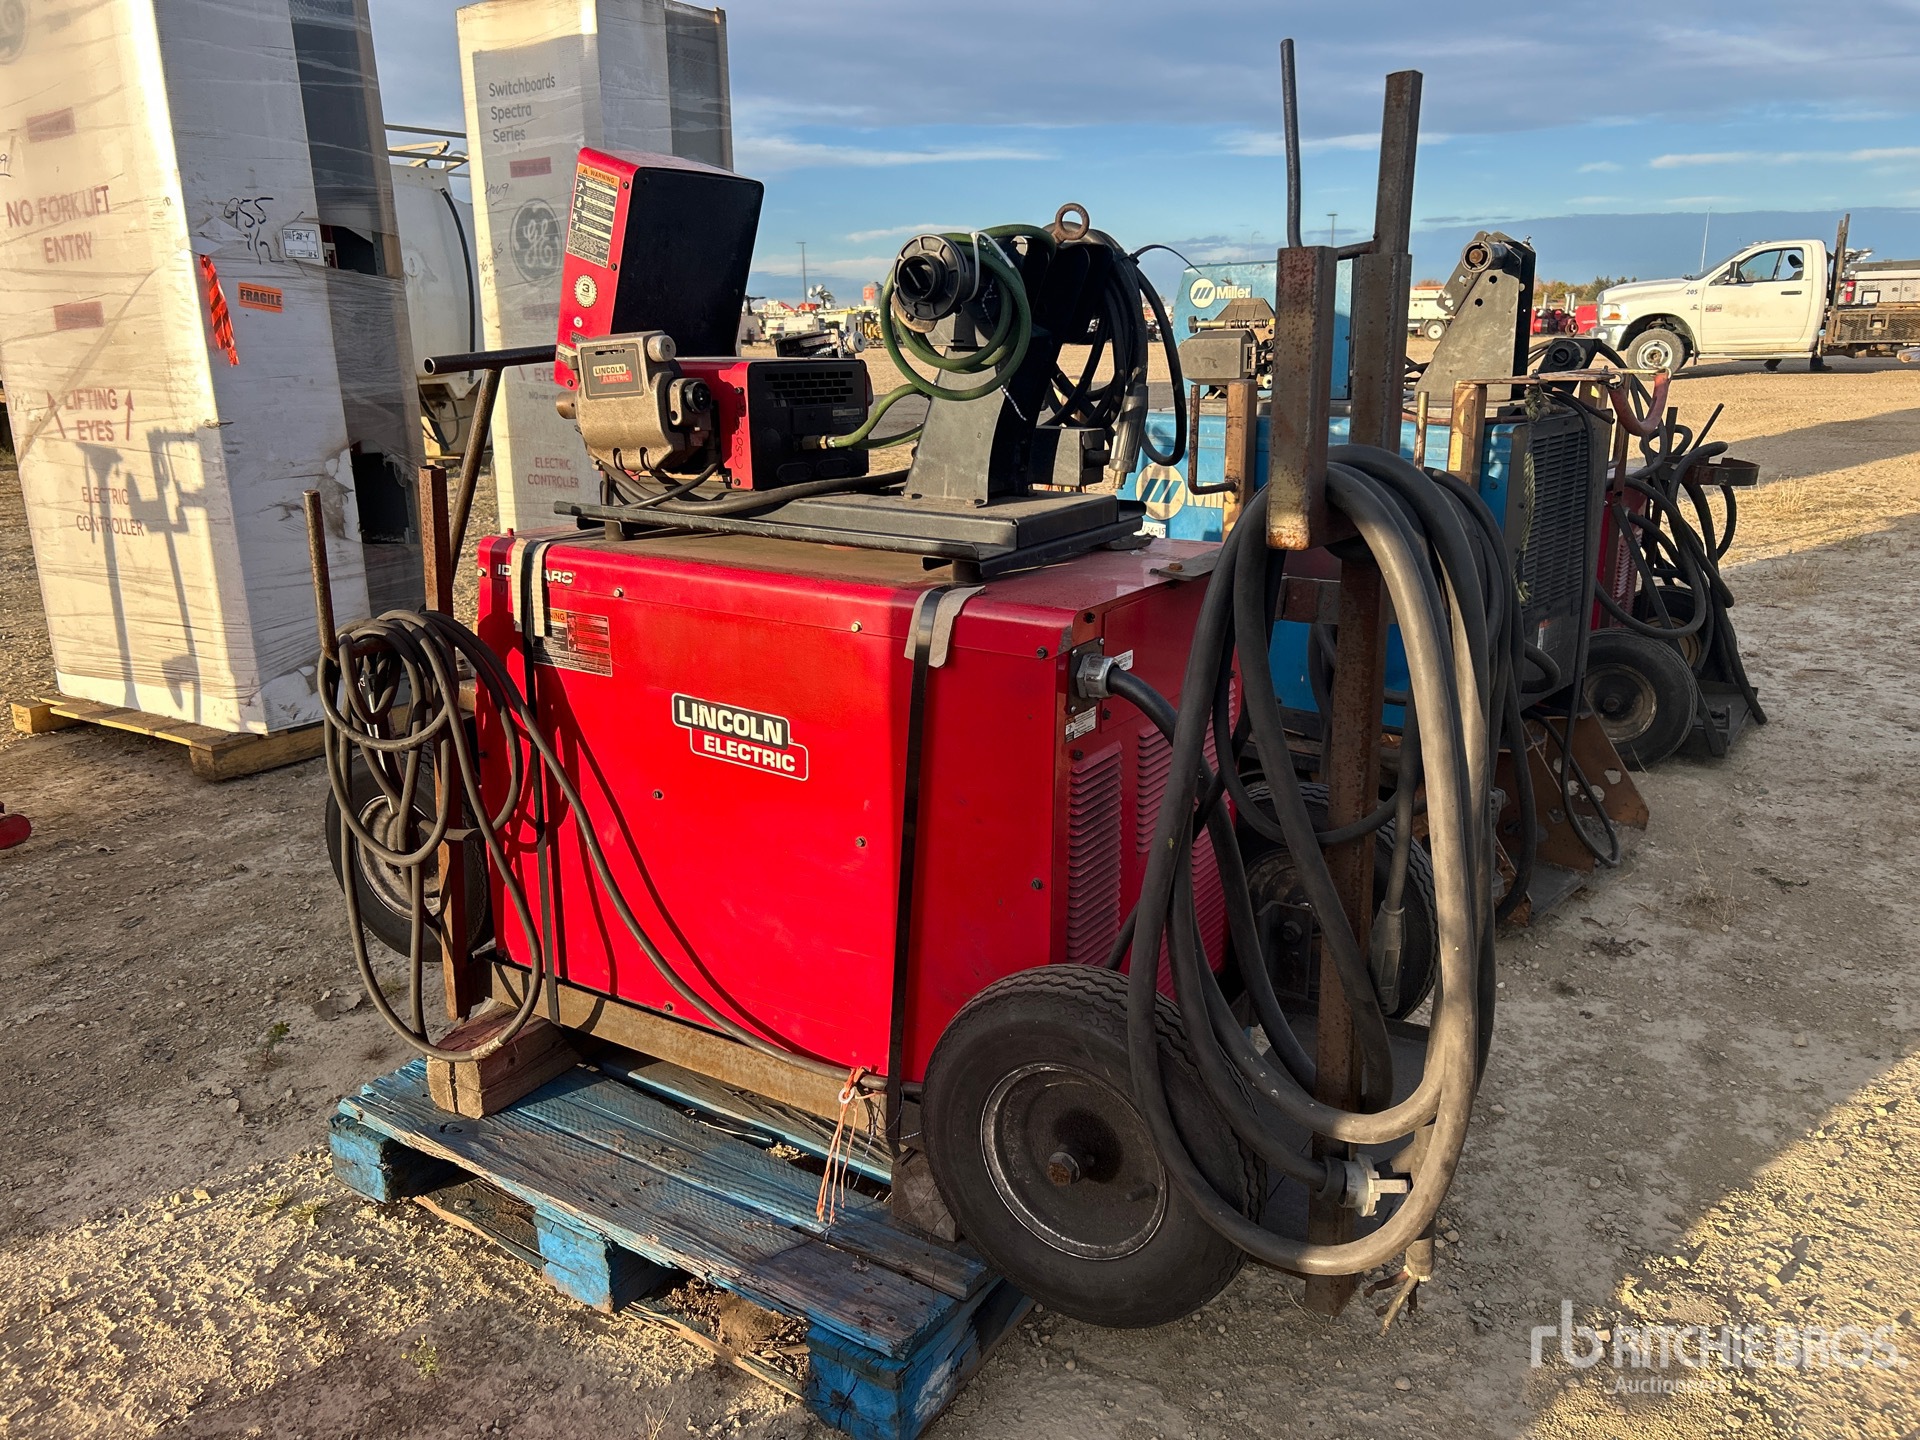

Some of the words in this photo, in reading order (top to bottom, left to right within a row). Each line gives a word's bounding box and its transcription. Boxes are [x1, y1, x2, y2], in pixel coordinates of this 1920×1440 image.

[488, 73, 556, 97] Switchboards
[490, 104, 532, 123] Spectra
[492, 128, 526, 142] Series
[6, 199, 33, 227] NO
[43, 231, 93, 264] ENTRY
[240, 289, 282, 306] FRAGILE
[582, 283, 590, 293] 3
[1216, 286, 1251, 300] Miller
[534, 366, 554, 382] EYE
[594, 366, 625, 375] LINCOLN
[602, 375, 629, 383] ELECTRIC
[65, 388, 118, 411] LIFTING
[76, 420, 115, 442] EYES
[535, 456, 571, 471] ELECTRIC
[528, 473, 579, 489] CONTROLLER
[82, 486, 129, 506] ELECTRIC
[1187, 482, 1223, 509] Mil
[76, 515, 144, 537] CONTROLLER
[498, 564, 573, 583] IDARC
[678, 699, 783, 746] LINCOLN
[703, 734, 796, 772] ELECTRIC
